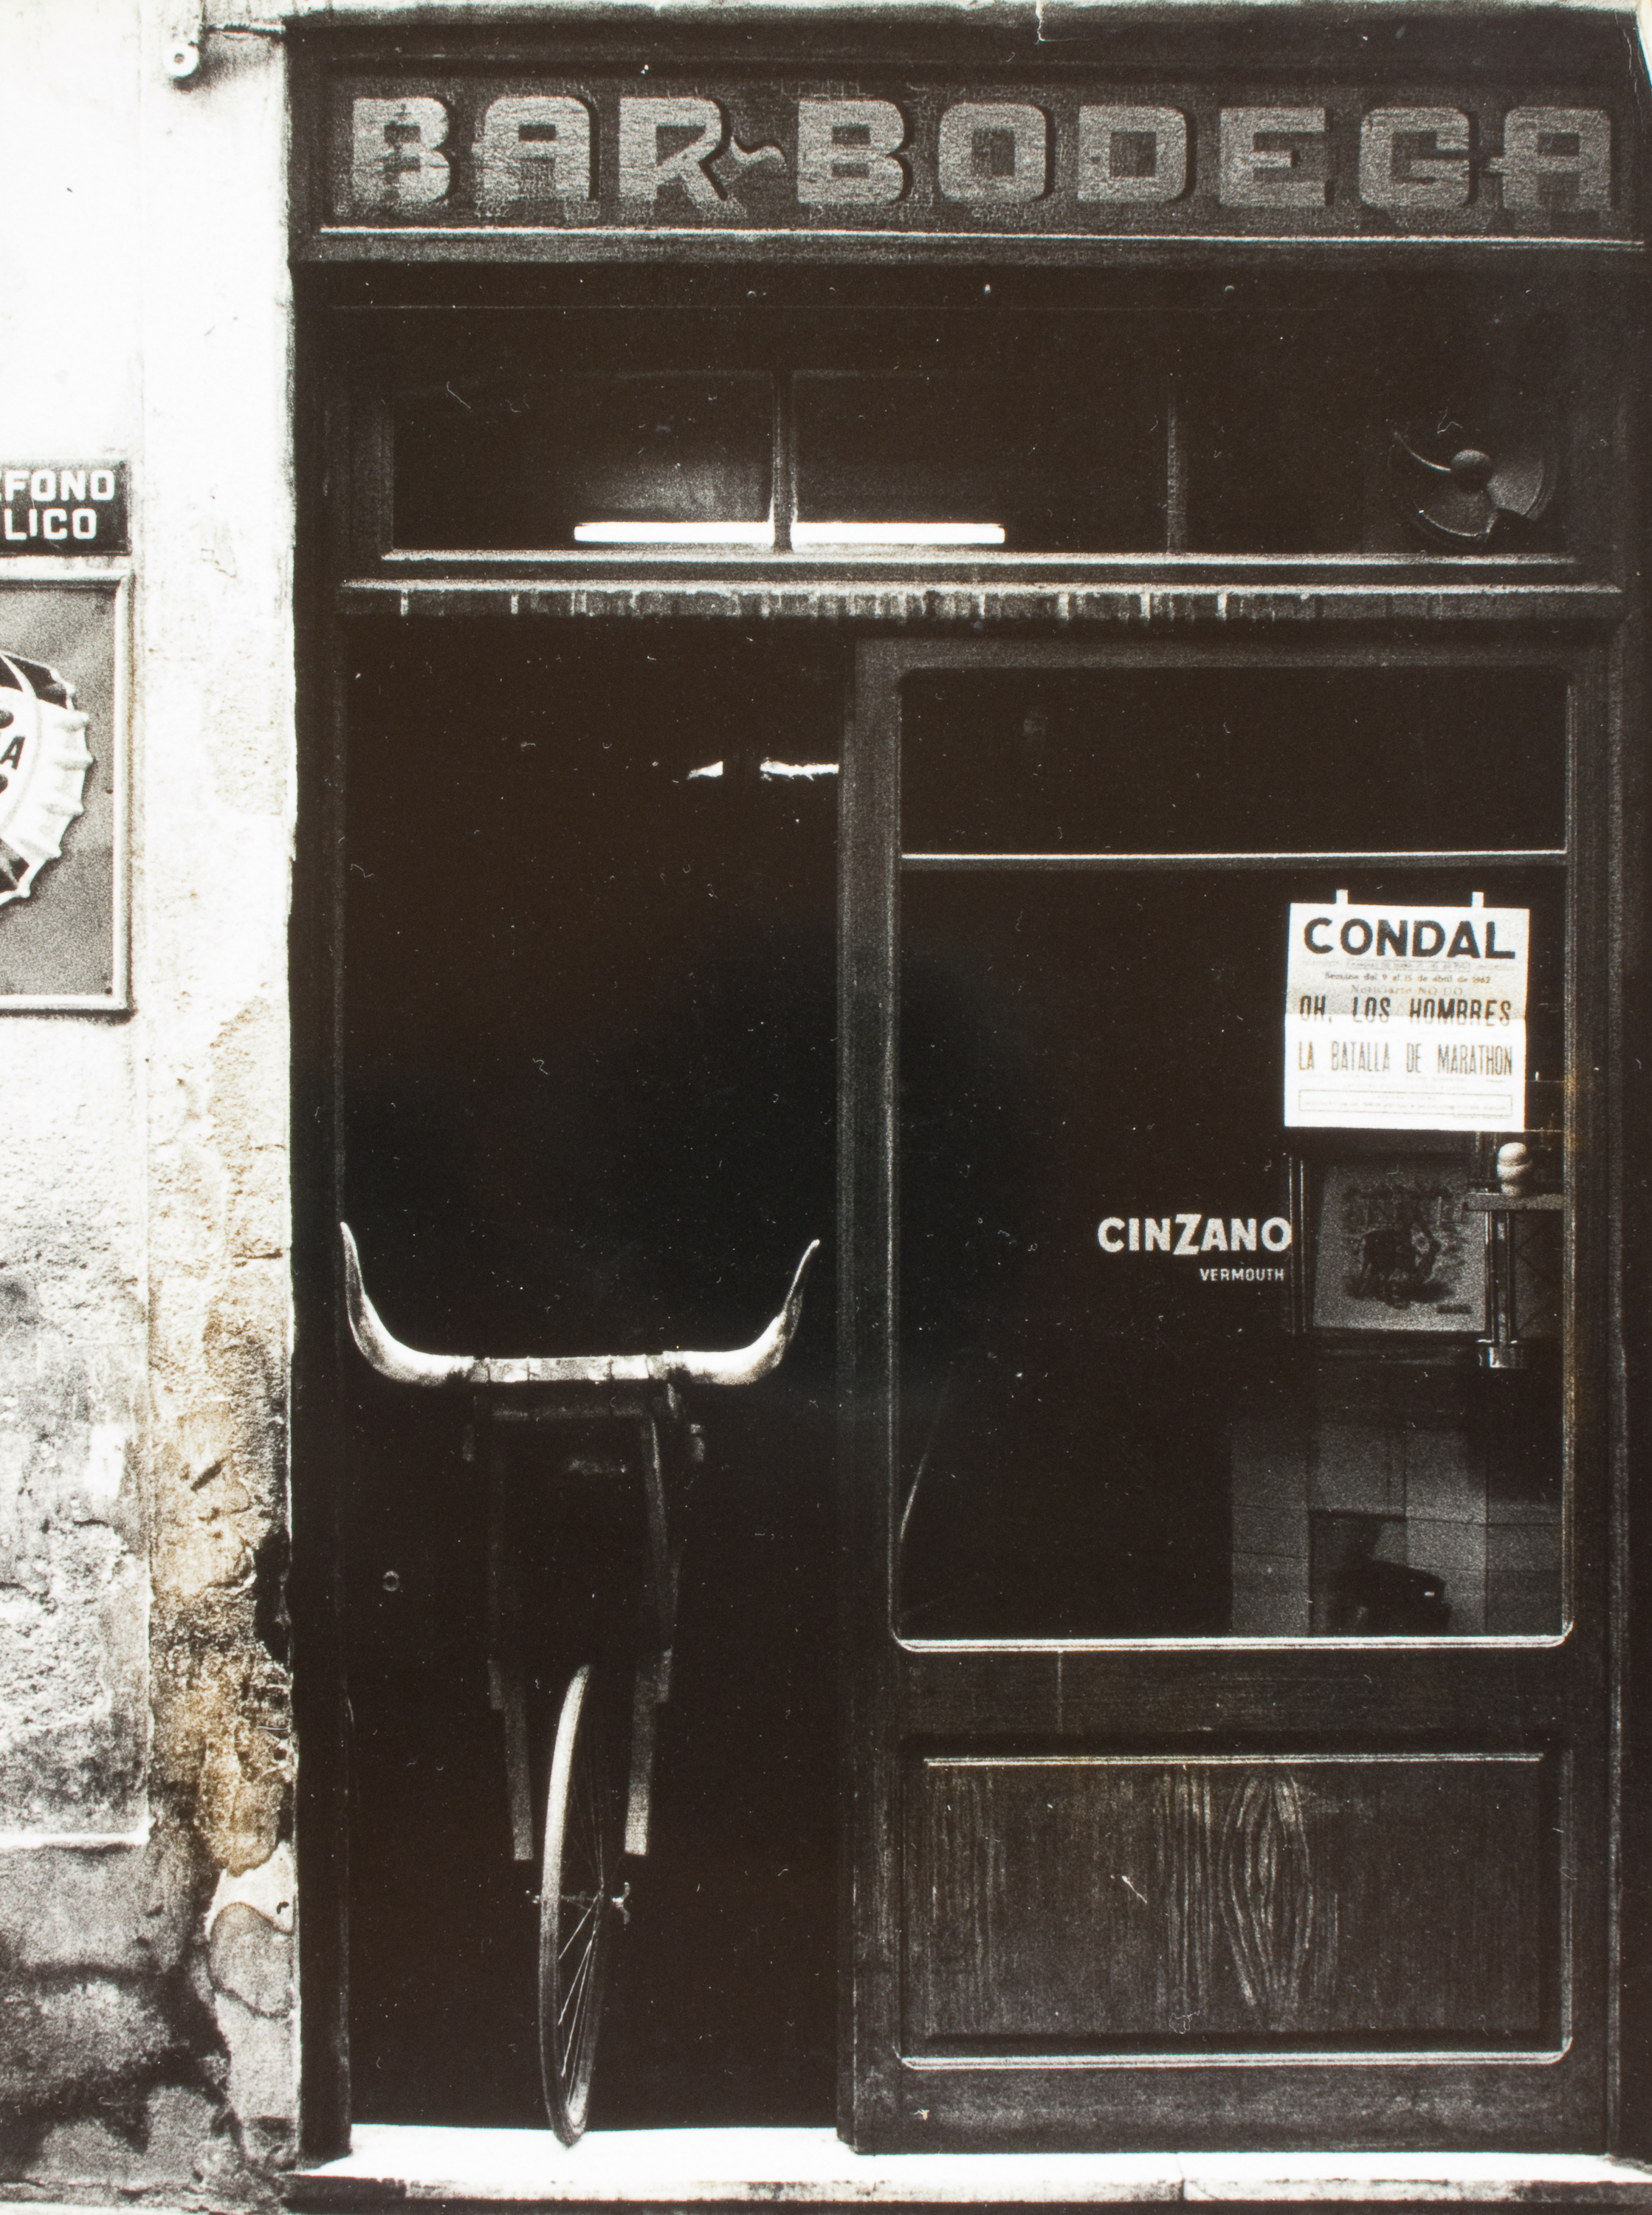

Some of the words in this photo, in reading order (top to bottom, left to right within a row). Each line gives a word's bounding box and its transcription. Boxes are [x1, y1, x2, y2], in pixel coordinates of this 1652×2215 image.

[796, 99, 1614, 214] BODEGA
[0, 469, 115, 501] FONO
[4, 507, 97, 540] LICO
[1304, 917, 1516, 960] CONDAL
[1352, 996, 1391, 1024] LOS
[1409, 998, 1512, 1027] HOMBRES
[1298, 1040, 1315, 1071] LA
[1331, 1040, 1391, 1073] BATALLA
[1405, 1043, 1422, 1074] DE
[1437, 1043, 1513, 1076] MARATHON
[1097, 1213, 1293, 1255] CINZANO
[1200, 1268, 1285, 1282] VERMOUTH
